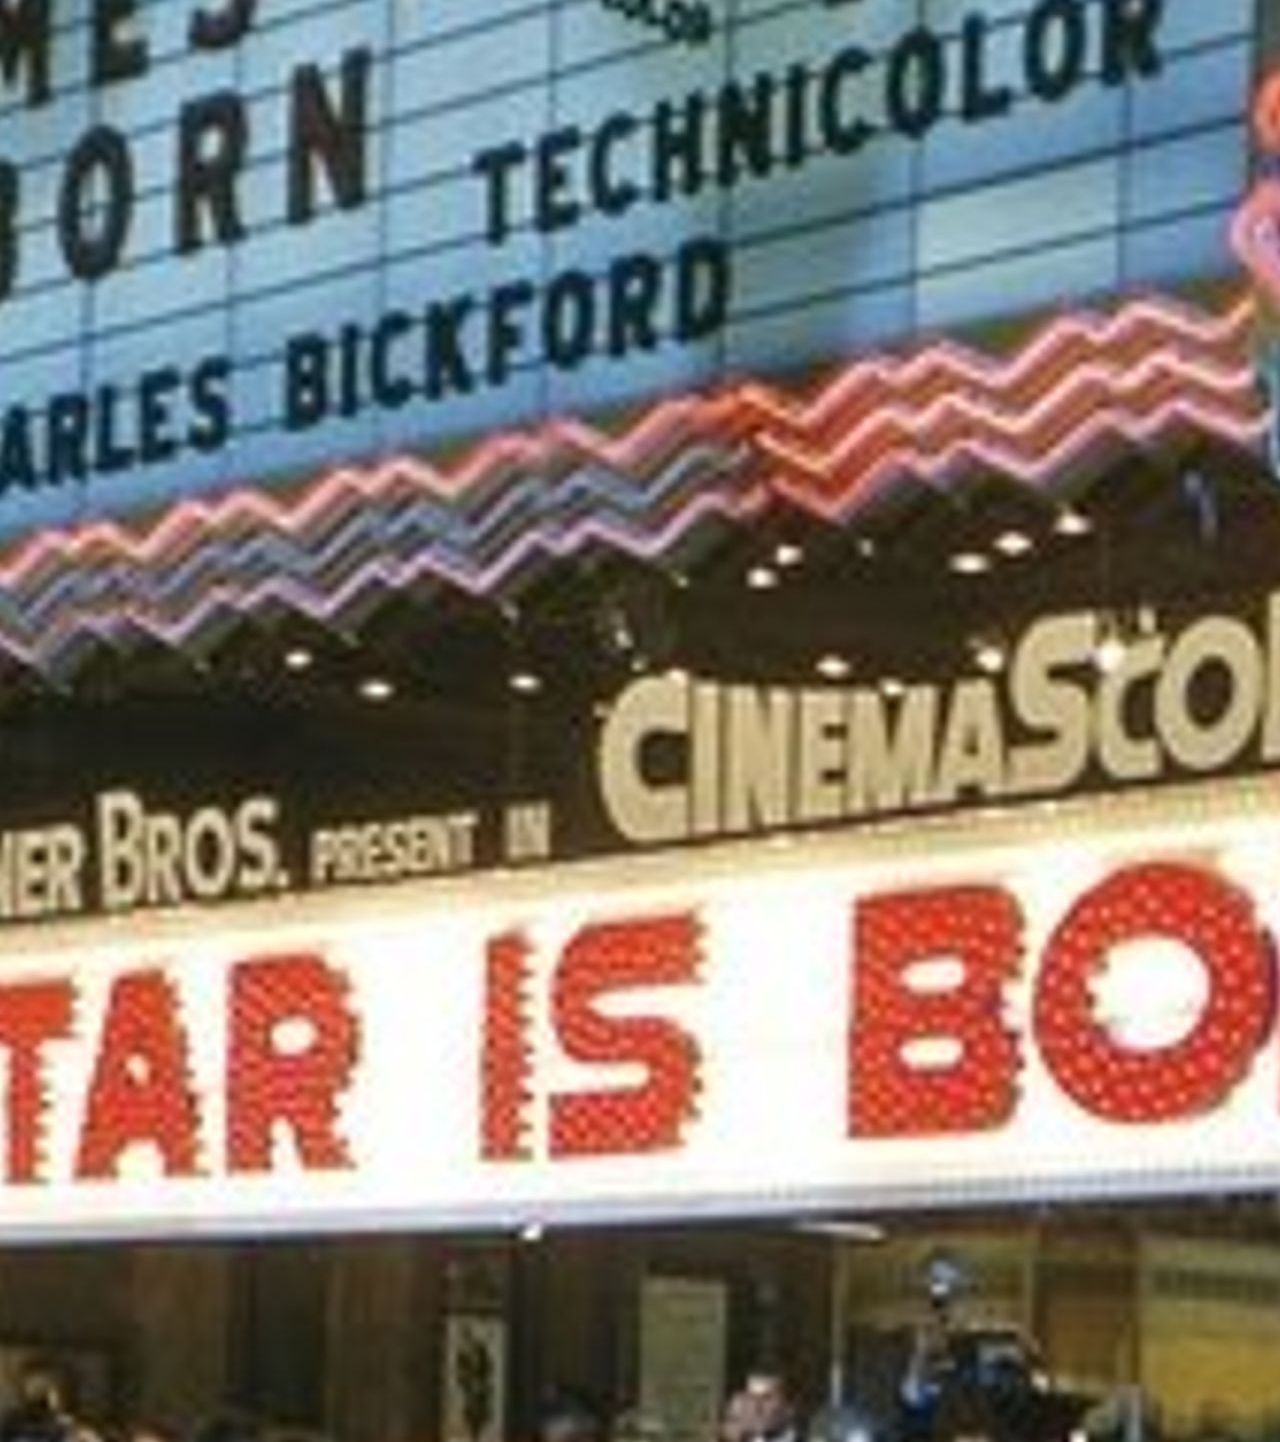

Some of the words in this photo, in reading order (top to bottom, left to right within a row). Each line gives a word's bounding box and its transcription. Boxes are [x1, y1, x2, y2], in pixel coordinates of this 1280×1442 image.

[283, 236, 730, 434] BICKFORD
[97, 790, 289, 908] BROS.
[310, 813, 478, 884] PRESENT
[505, 803, 551, 859] IN
[479, 909, 705, 1161] IS
